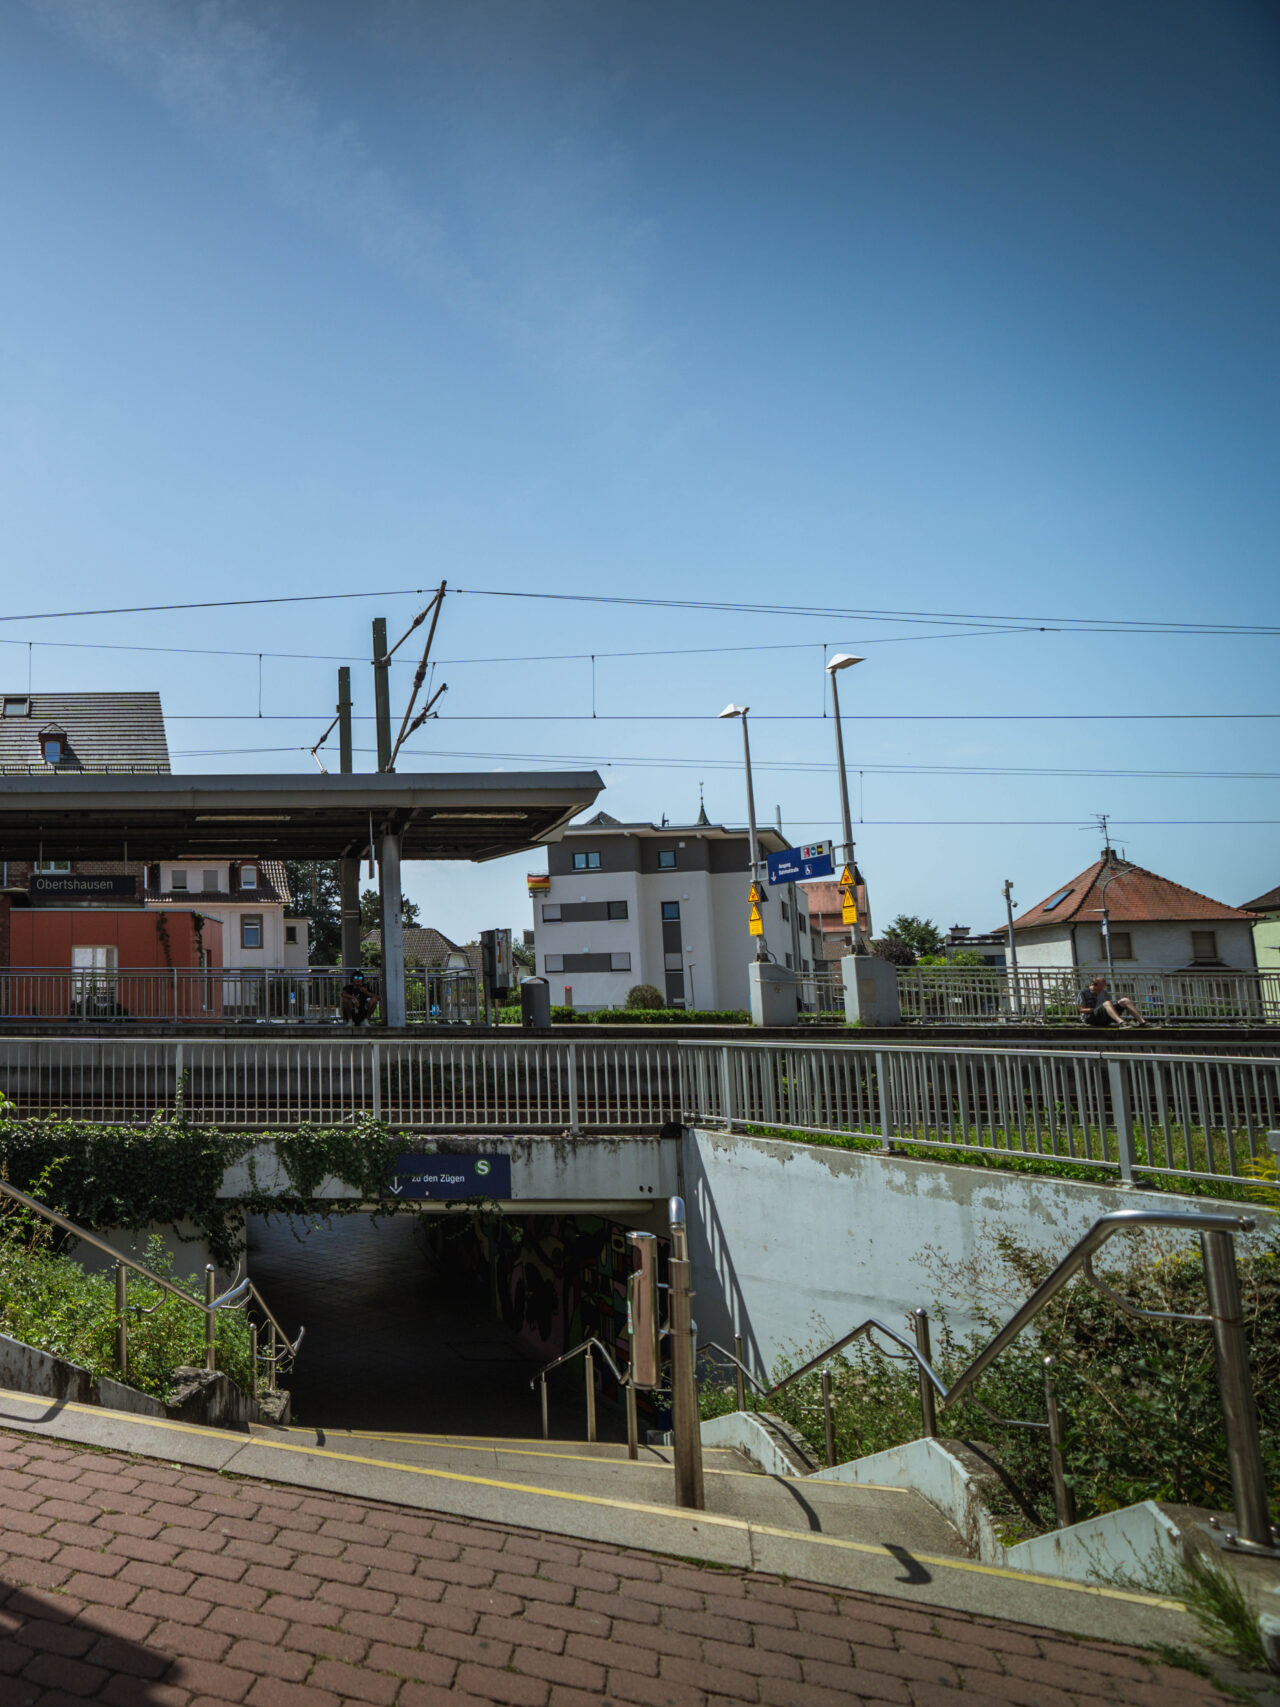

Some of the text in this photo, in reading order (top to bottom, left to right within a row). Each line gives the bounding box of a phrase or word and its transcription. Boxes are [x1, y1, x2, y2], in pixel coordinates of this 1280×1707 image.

[36, 879, 114, 890] Obertshausen
[477, 1160, 489, 1175] S
[423, 1174, 438, 1183] den
[440, 1174, 465, 1184] Zügen
